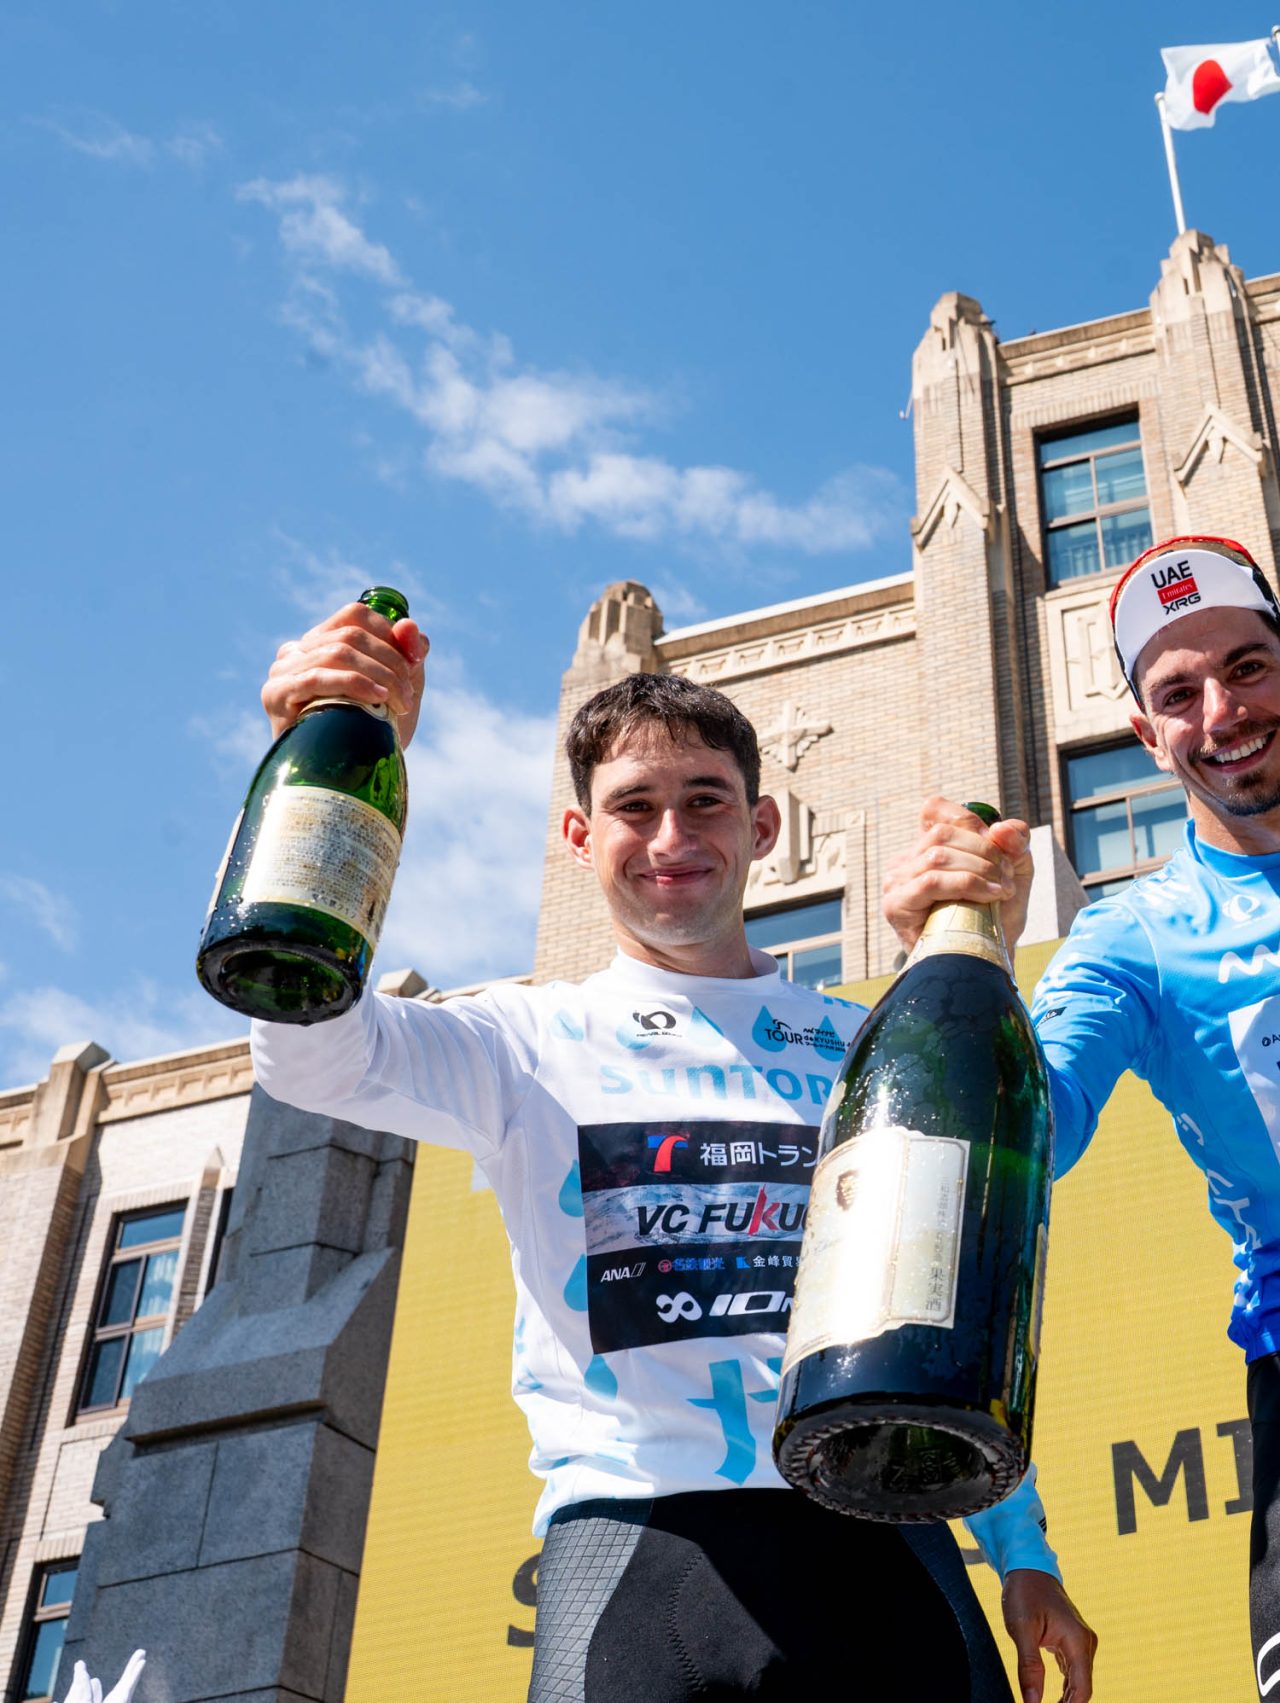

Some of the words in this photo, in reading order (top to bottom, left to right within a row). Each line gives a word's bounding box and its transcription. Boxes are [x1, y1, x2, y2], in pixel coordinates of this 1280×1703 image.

[1151, 560, 1193, 589] UAE
[1162, 584, 1193, 599] Emirates
[1163, 592, 1201, 615] XRG
[765, 1028, 803, 1045] TOUR
[814, 1037, 845, 1046] KYUSHU
[700, 1142, 816, 1167] 福岡トラン
[638, 1204, 690, 1236] VC
[699, 1184, 808, 1236] FUKU
[601, 1268, 631, 1283] ANA
